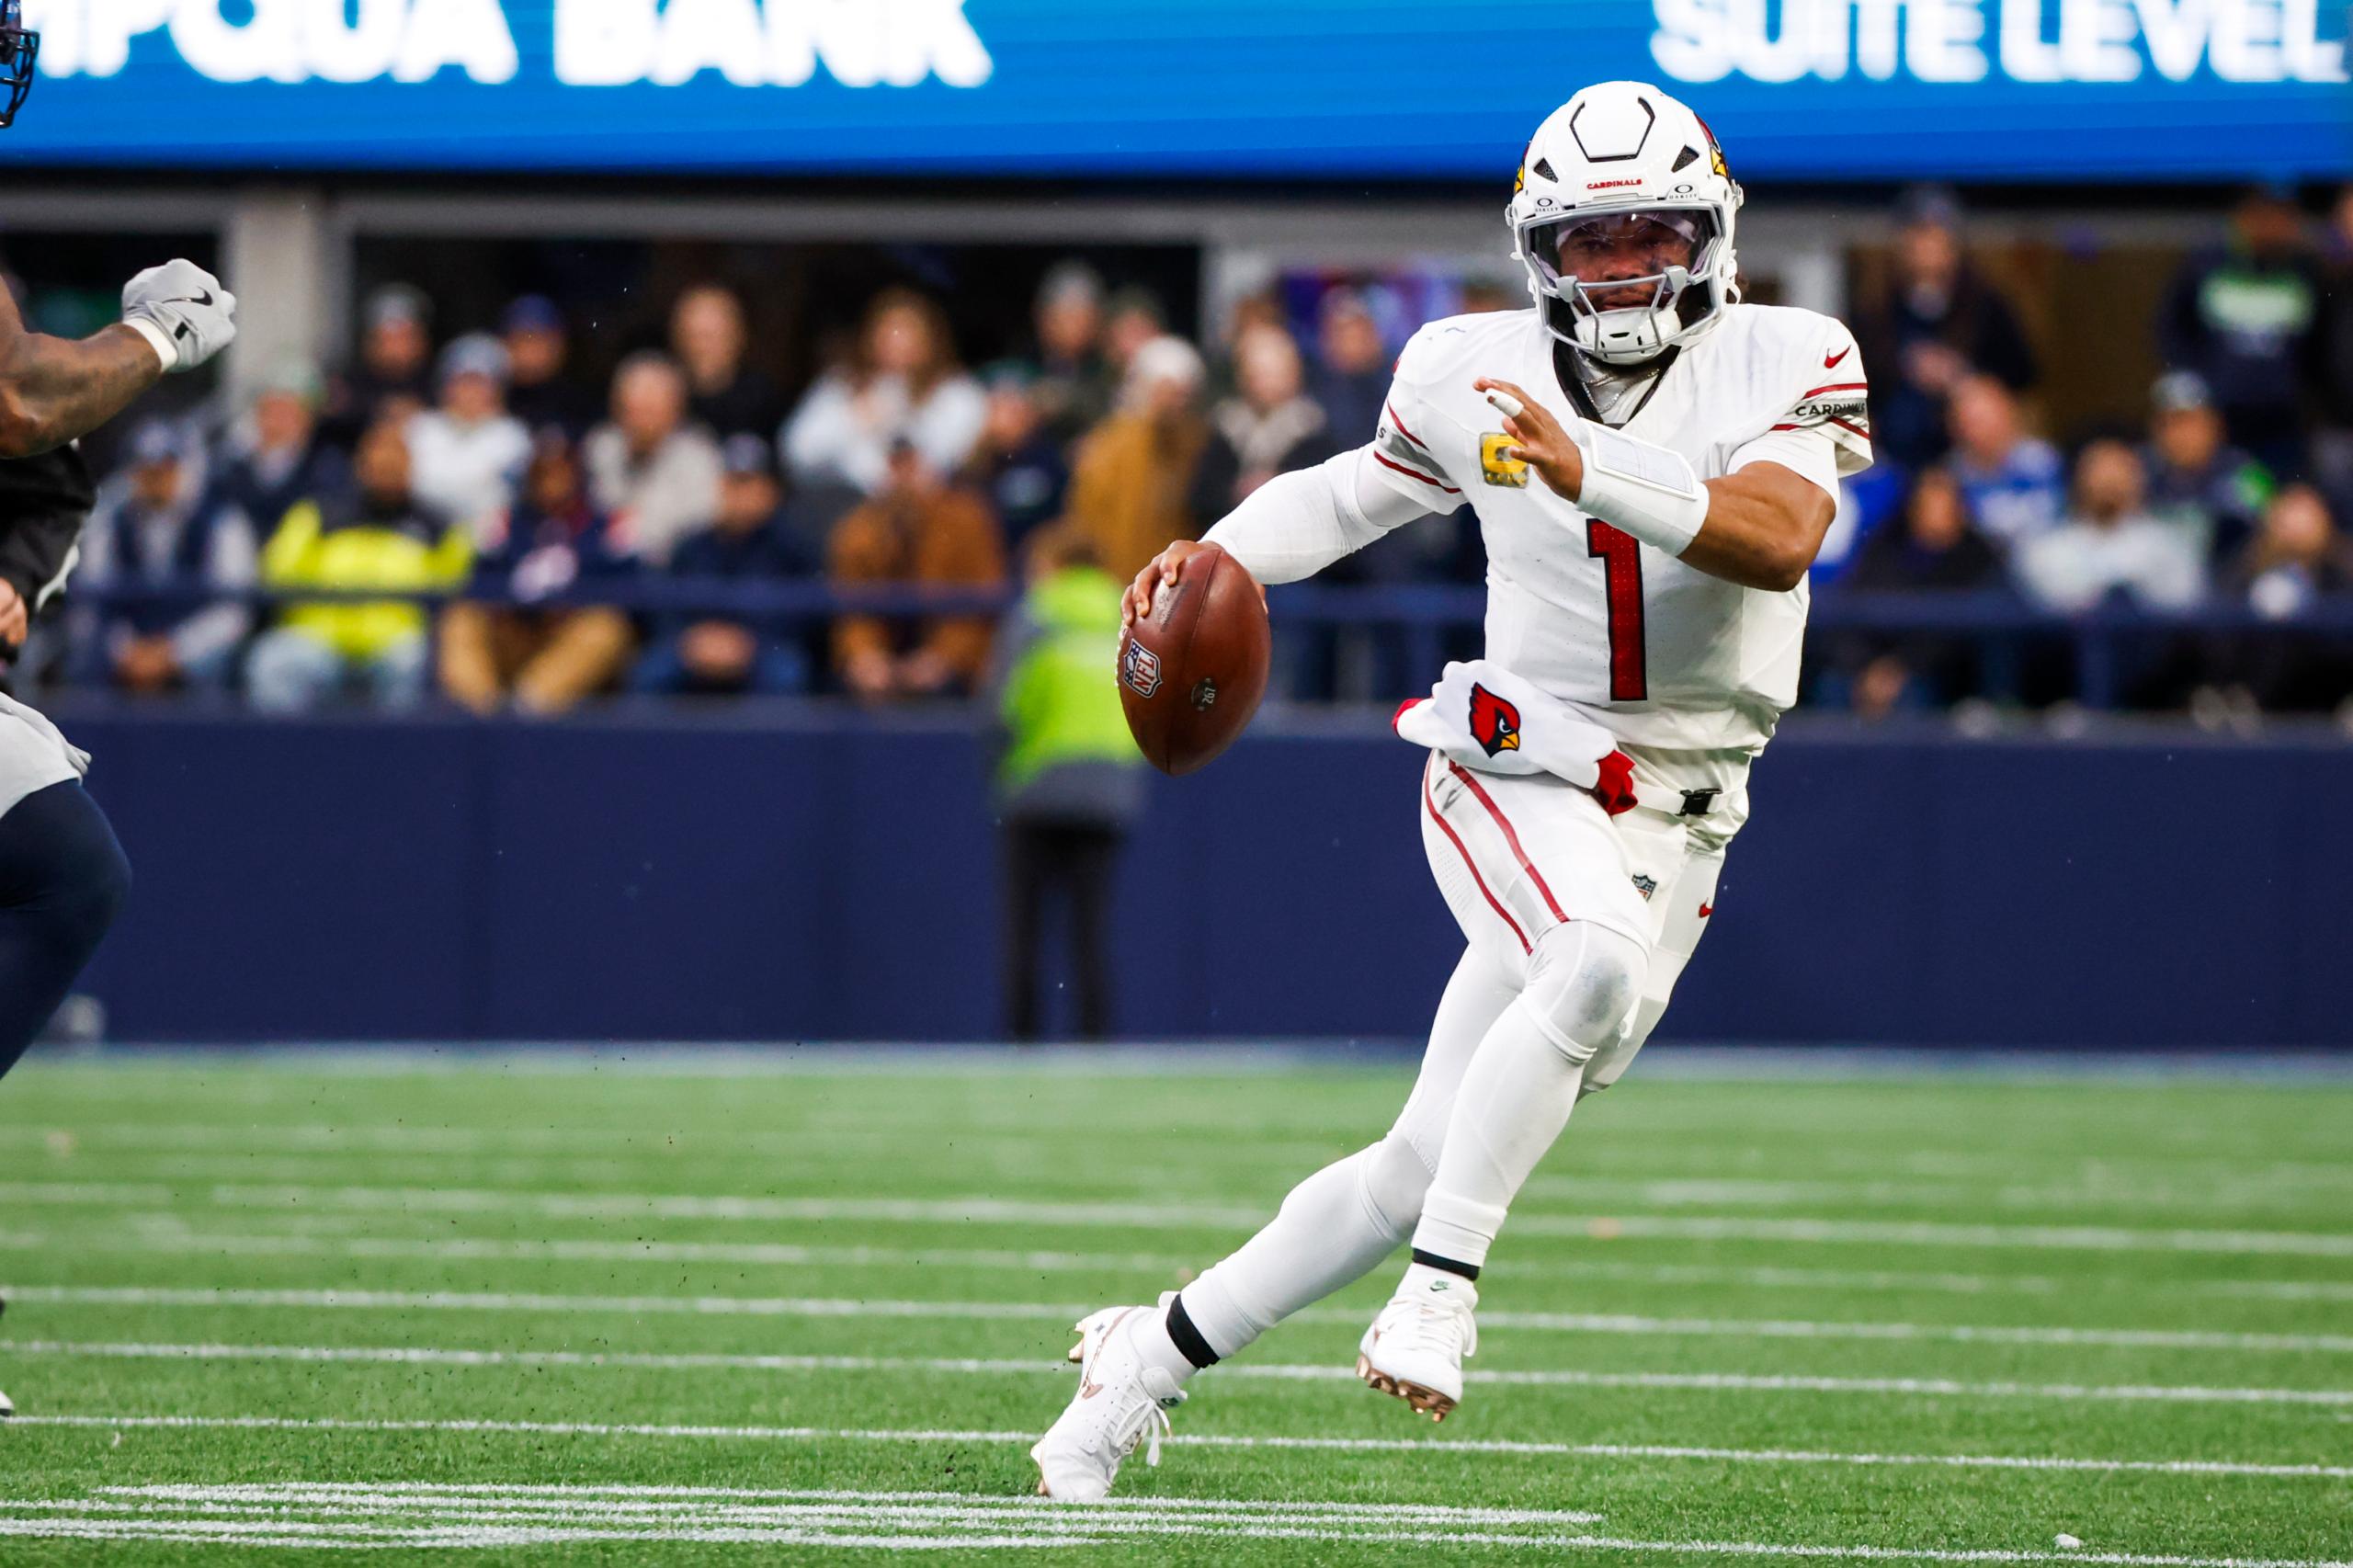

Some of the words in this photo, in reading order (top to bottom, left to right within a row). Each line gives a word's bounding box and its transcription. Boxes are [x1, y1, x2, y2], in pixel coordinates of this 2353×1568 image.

[553, 0, 995, 87] BANK
[1650, 0, 1989, 83] SUITE
[2000, 0, 2350, 83] LEVEL
[1586, 178, 1643, 189] CARDINALS
[1586, 517, 1648, 701] 1
[1133, 656, 1155, 693] NFL
[1201, 687, 1216, 704] 267
